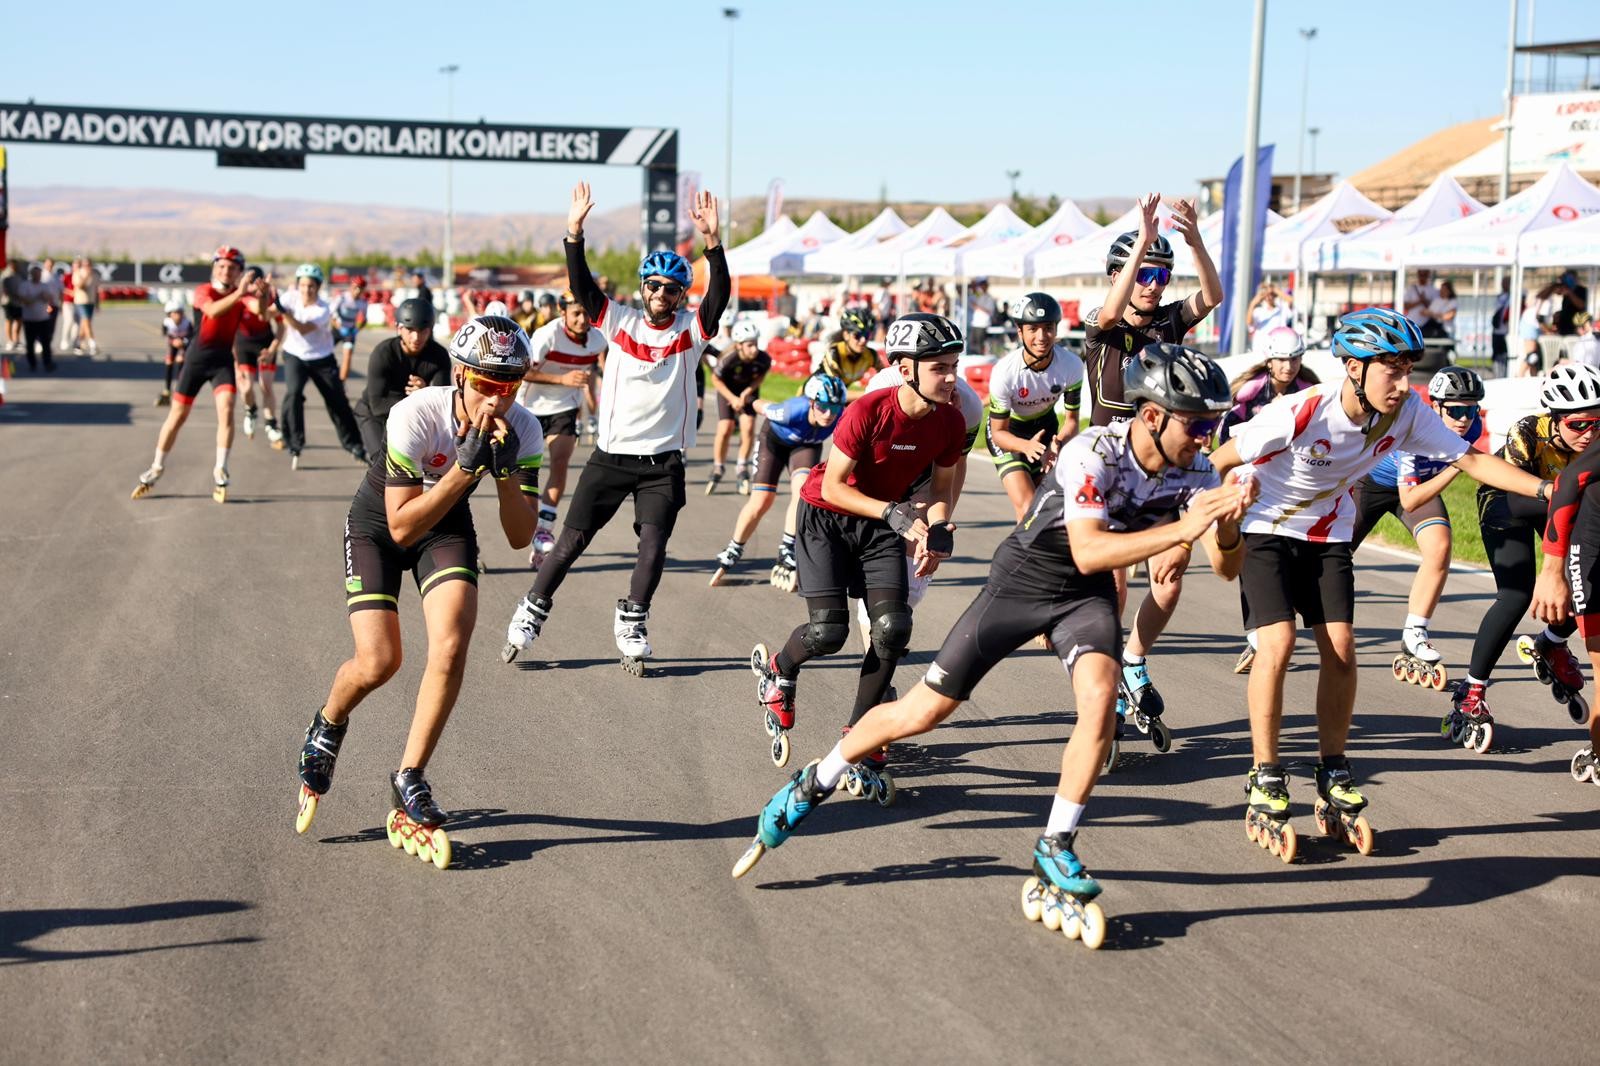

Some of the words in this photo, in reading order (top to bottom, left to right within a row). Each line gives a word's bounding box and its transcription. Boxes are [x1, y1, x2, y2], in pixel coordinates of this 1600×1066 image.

[0, 111, 191, 146] KAPADOKYA
[195, 119, 303, 150] MOTOR
[307, 124, 441, 156] SPORLARI
[889, 324, 913, 346] 32
[1300, 456, 1332, 467] VIGOR
